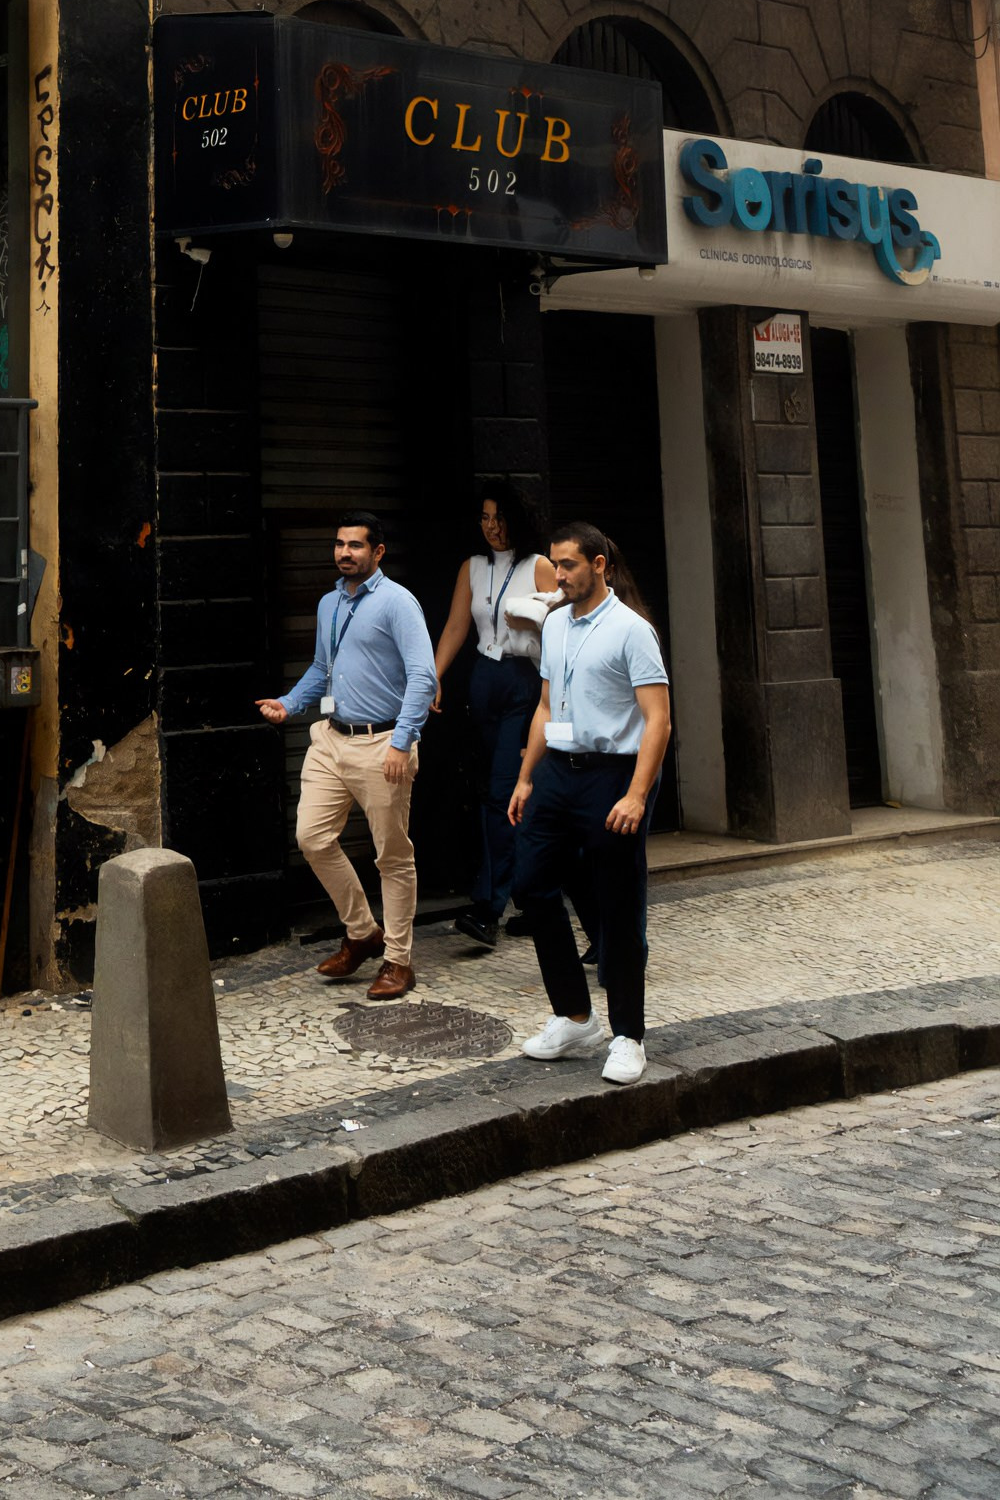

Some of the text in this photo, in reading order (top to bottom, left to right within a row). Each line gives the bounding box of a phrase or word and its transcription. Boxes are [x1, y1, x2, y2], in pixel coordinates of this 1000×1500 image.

[182, 86, 248, 123] CLUB
[201, 127, 229, 148] 502
[404, 96, 572, 163] CLUB
[469, 167, 518, 197] 502
[680, 138, 942, 286] Sorrisus
[755, 352, 802, 370] 98474-8939
